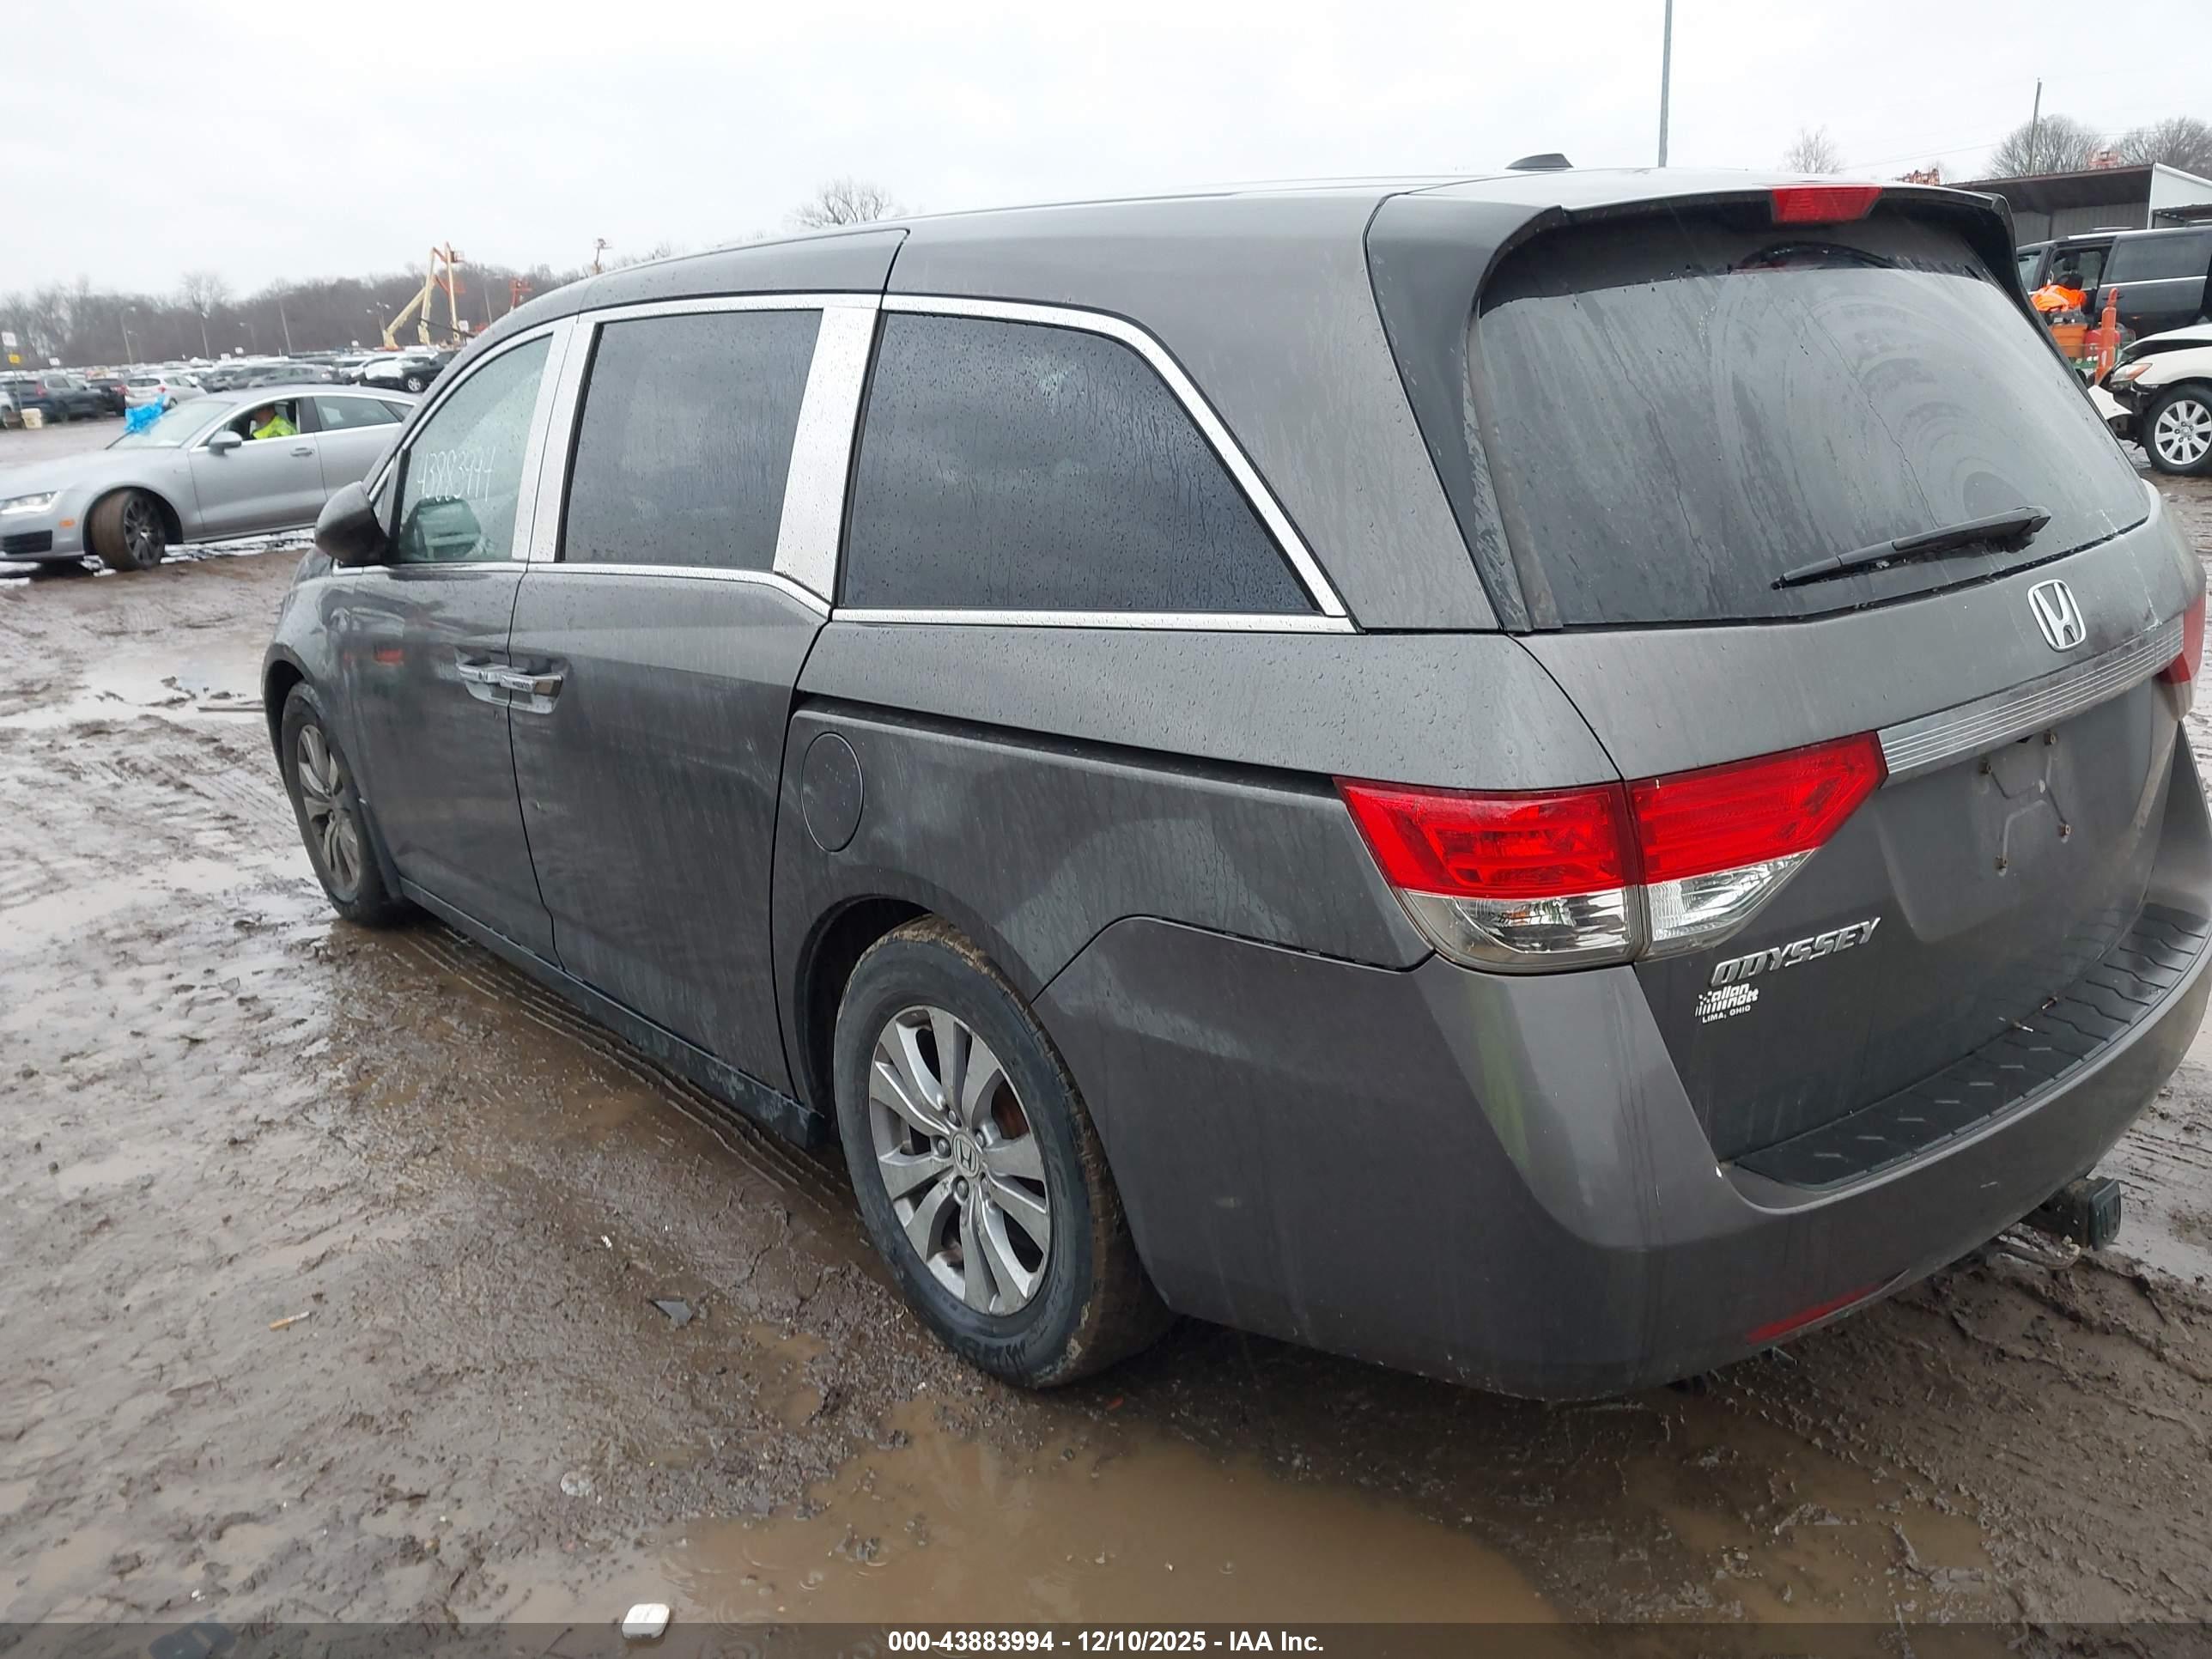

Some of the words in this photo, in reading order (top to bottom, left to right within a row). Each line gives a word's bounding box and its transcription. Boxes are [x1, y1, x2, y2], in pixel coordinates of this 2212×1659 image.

[1710, 917, 1881, 987] ODYSSEY
[1702, 1012, 1727, 1024] LIMA,
[1729, 1005, 1751, 1016] OHIO
